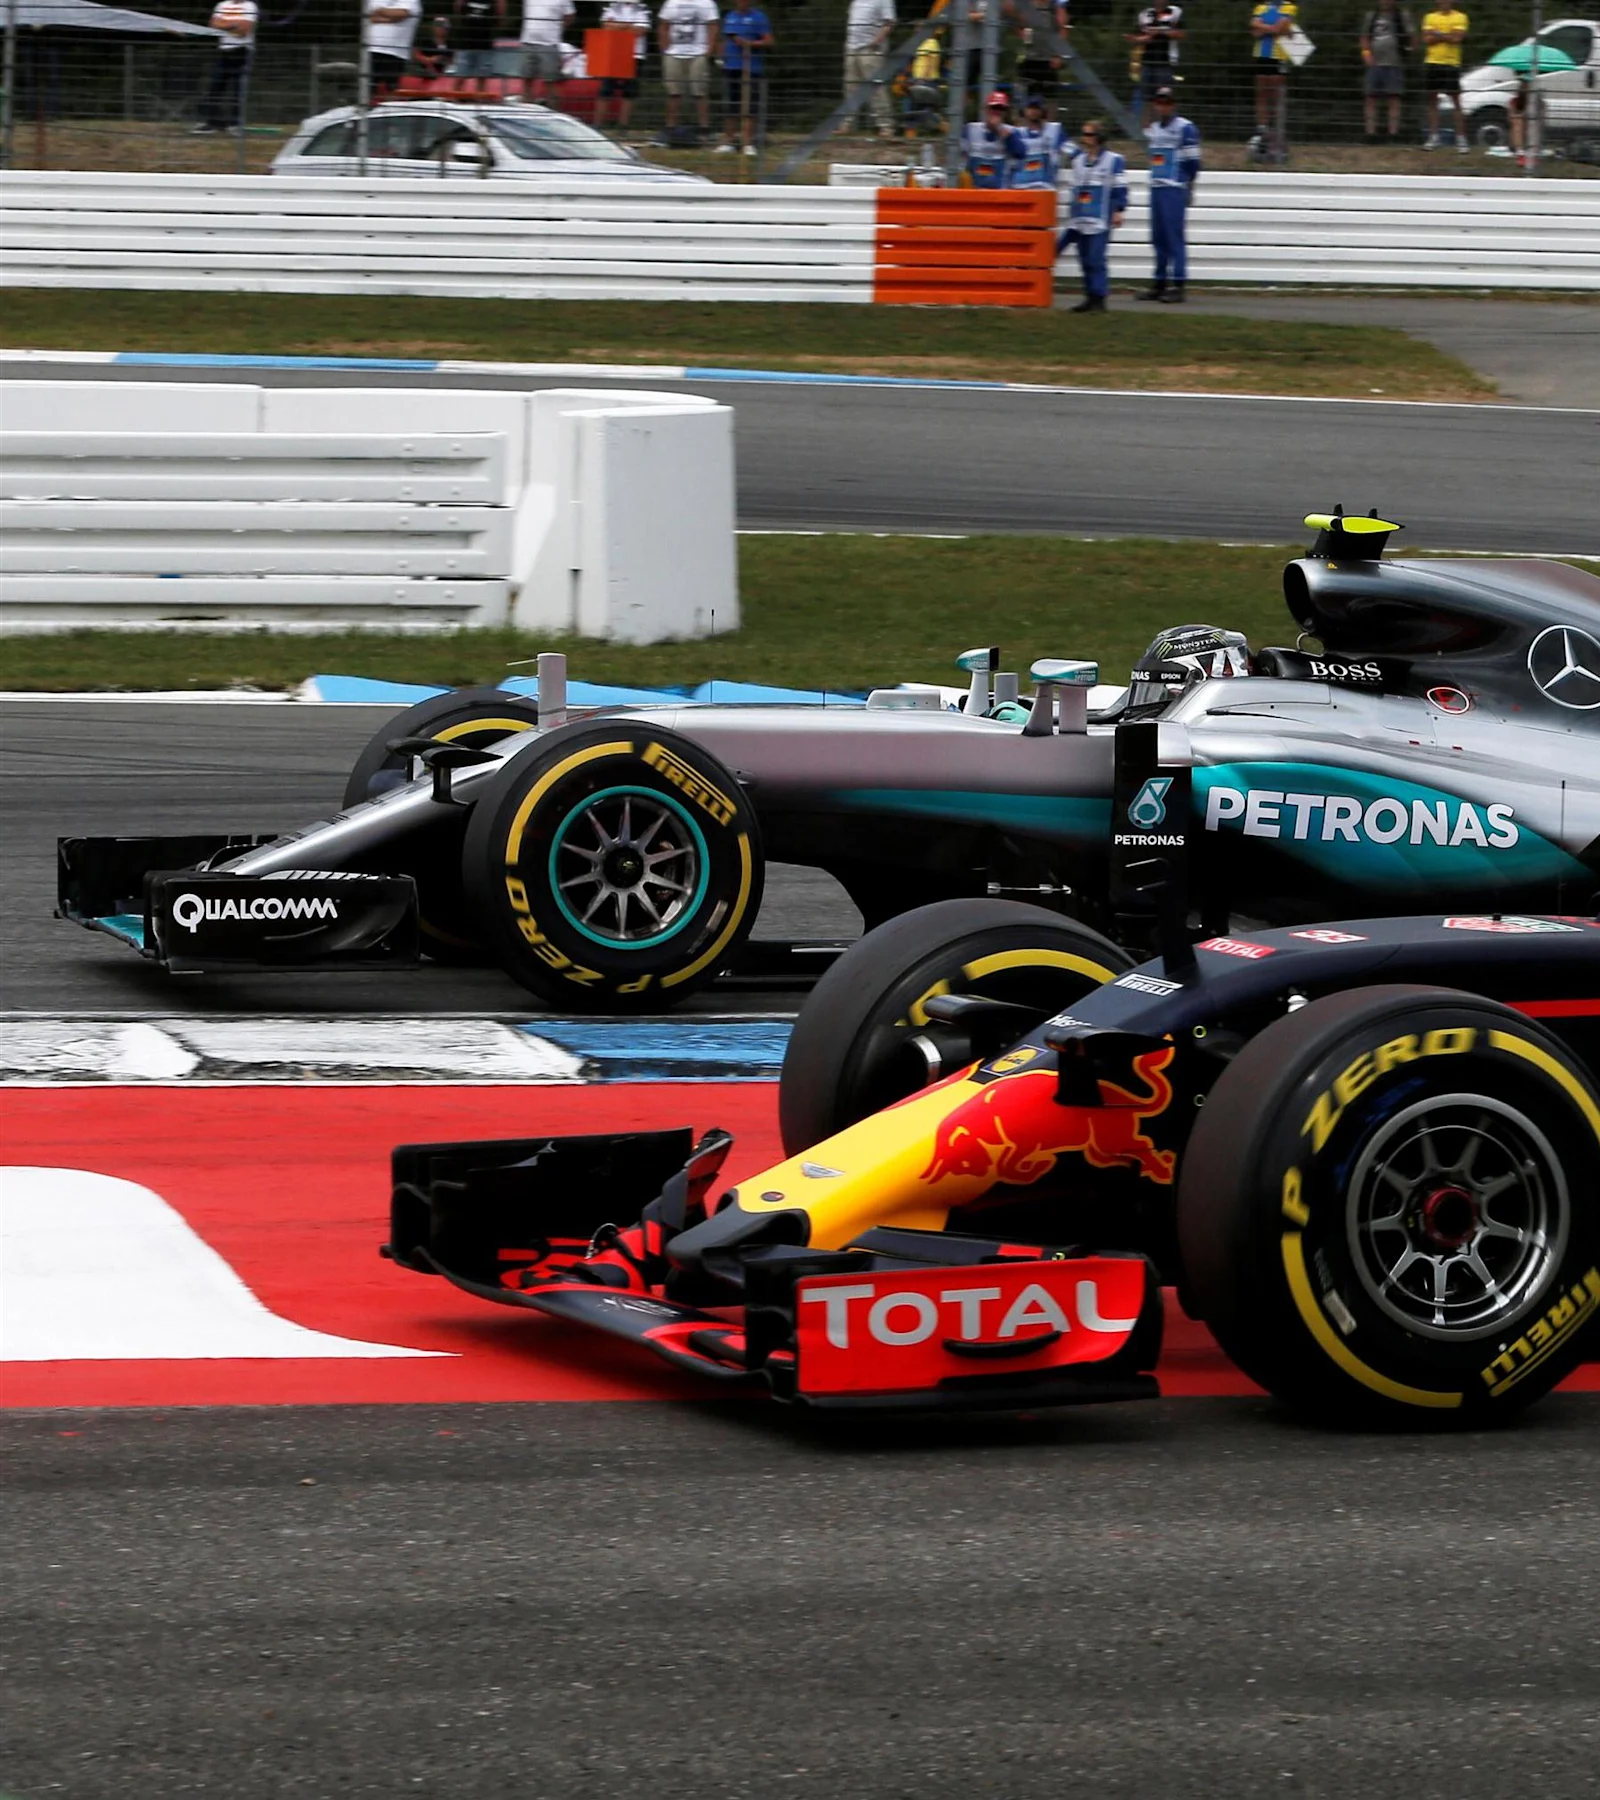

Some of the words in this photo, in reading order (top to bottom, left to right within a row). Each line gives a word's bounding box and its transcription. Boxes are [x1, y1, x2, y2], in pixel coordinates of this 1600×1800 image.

[1173, 638, 1218, 651] MONSTER
[1161, 672, 1181, 680] EPSON
[1309, 660, 1382, 678] BOSS
[641, 742, 737, 827] PIRELLI
[1205, 786, 1520, 849] PETRONAS
[1114, 835, 1185, 847] PETRONAS
[172, 893, 339, 933] QUALCOMM
[505, 876, 605, 987] ZERO
[1207, 937, 1264, 959] TOTAL
[1114, 973, 1185, 997] PIRELLI
[1301, 1027, 1478, 1154] ZERO
[802, 1279, 1138, 1349] TOTAL
